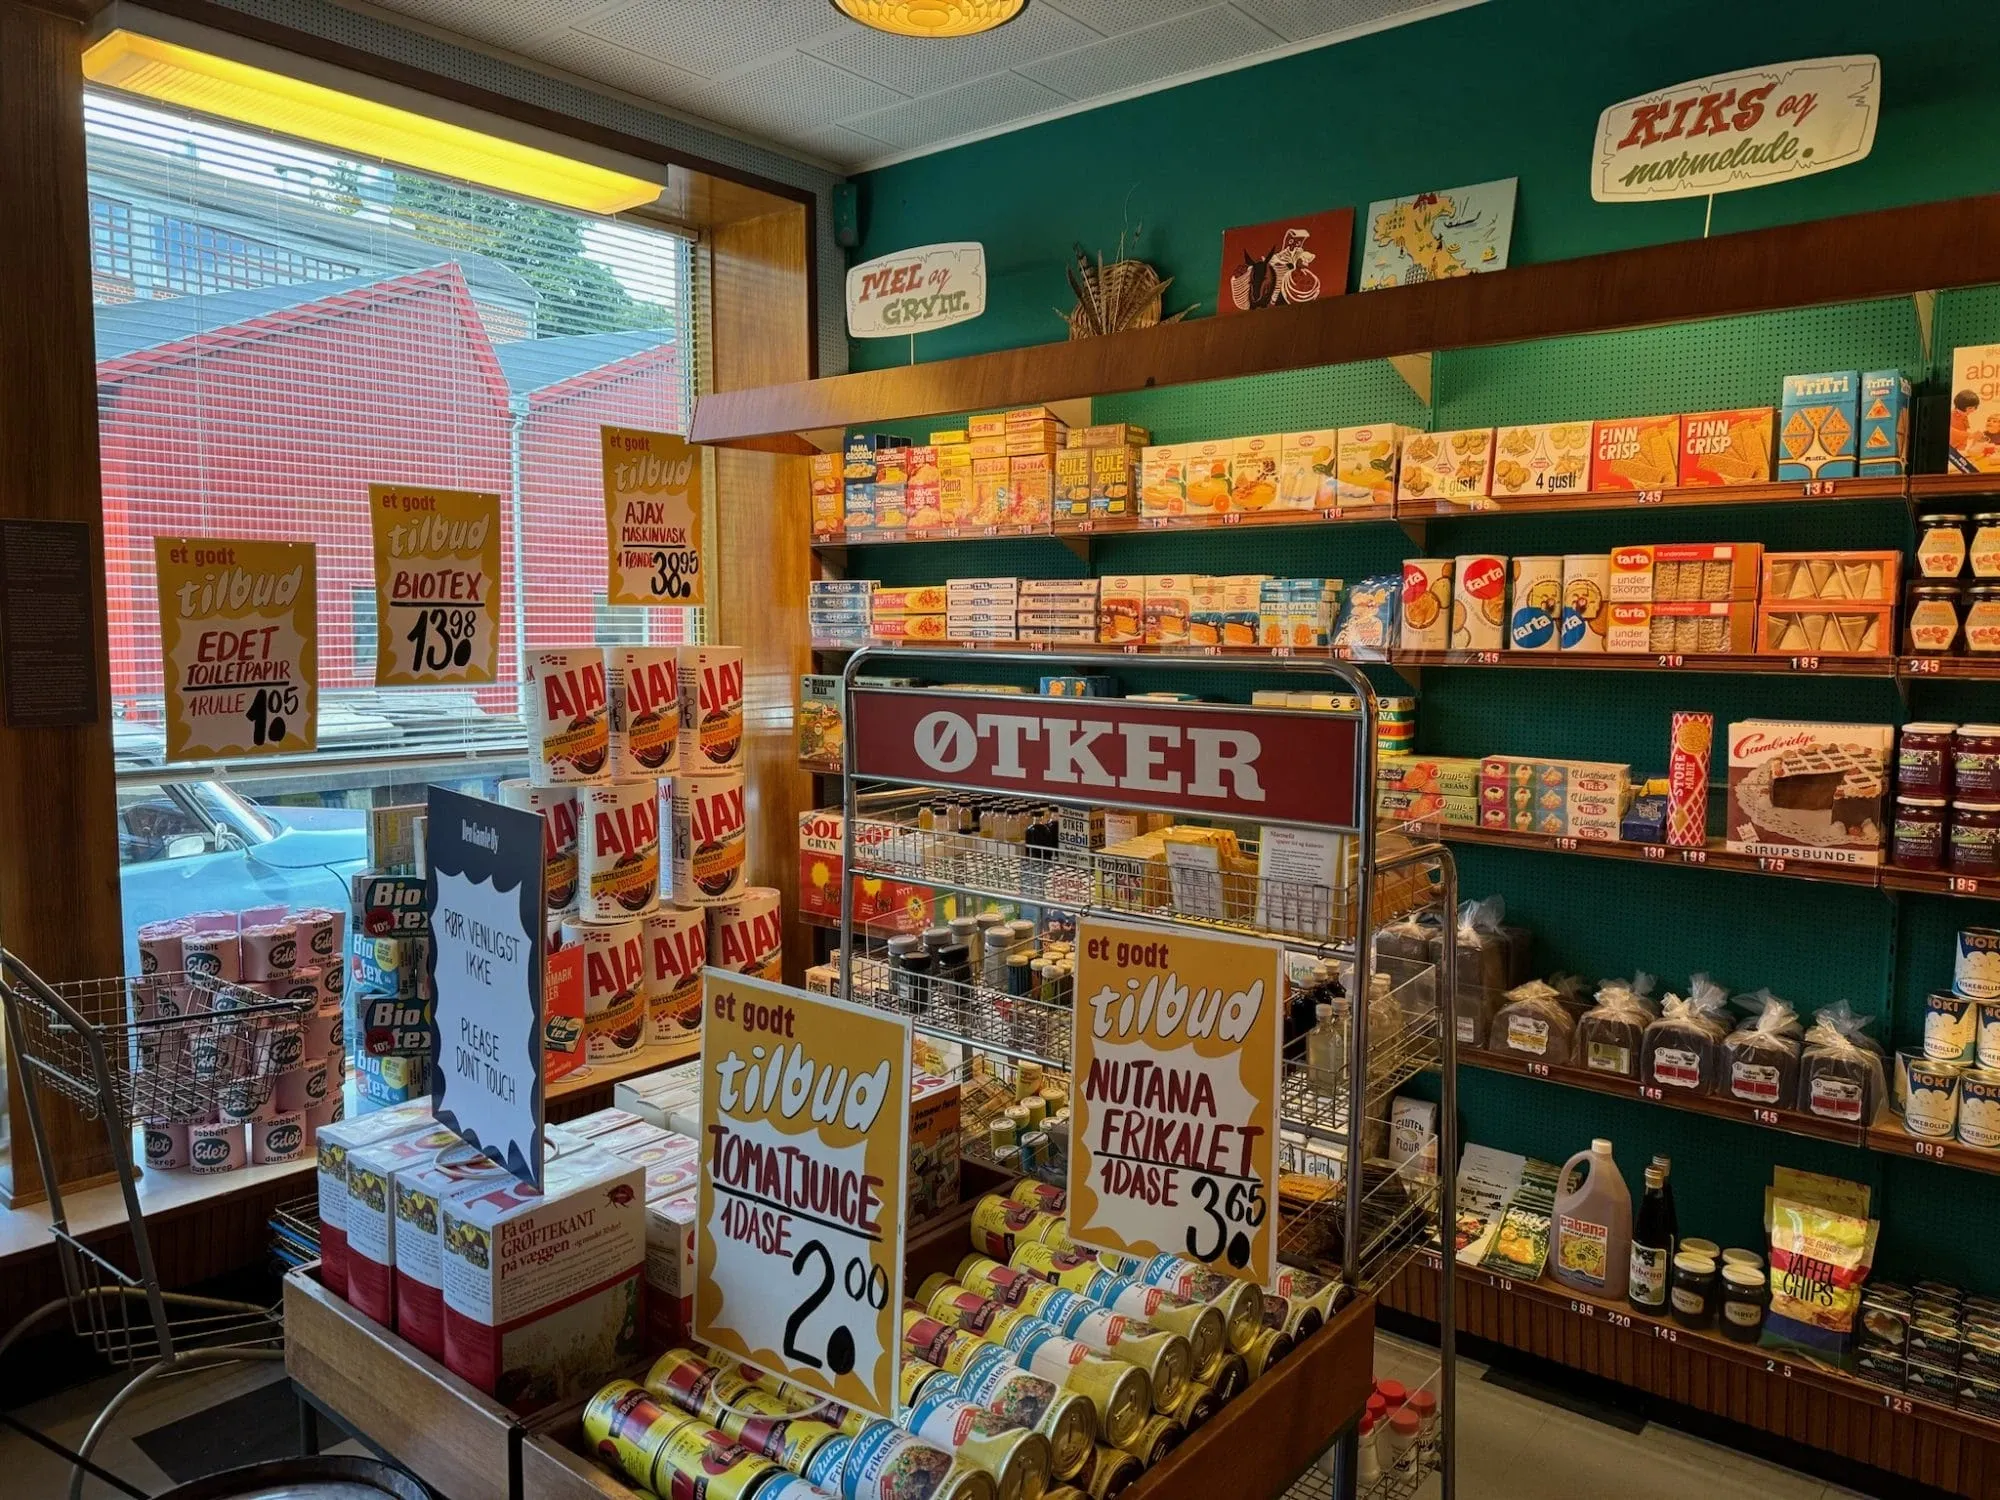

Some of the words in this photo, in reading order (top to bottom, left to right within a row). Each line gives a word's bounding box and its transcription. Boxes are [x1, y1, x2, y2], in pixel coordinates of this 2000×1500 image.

[1617, 81, 1778, 150] KIKS
[1776, 92, 1818, 127] og
[1619, 131, 1814, 187] marmelade.
[859, 263, 924, 303] MEL
[928, 267, 951, 295] og
[1795, 376, 1849, 396] TriTri
[1600, 426, 1639, 444] FINN
[1687, 419, 1730, 438] FINN
[610, 435, 621, 448] et
[625, 436, 650, 452] godt
[1600, 443, 1641, 461] CRISP
[1687, 437, 1732, 456] CRISP
[614, 453, 693, 492] tilbud
[1057, 457, 1086, 477] GULE
[1093, 454, 1124, 474] GULE
[1438, 476, 1447, 493] 4
[1536, 474, 1545, 489] 4
[1548, 471, 1578, 494] gusti
[1803, 481, 1835, 496] 135
[383, 493, 398, 509] et
[402, 495, 436, 513] godt
[1638, 490, 1662, 504] 245
[625, 501, 664, 525] AJAX
[387, 513, 490, 558] tilbud
[622, 526, 687, 544] MASKINVASK
[170, 547, 189, 564] et
[195, 547, 235, 567] godt
[1616, 553, 1650, 565] tarta
[392, 569, 481, 602] BIOTEX
[1466, 565, 1505, 590] tarta
[1617, 575, 1646, 585] under
[176, 565, 303, 618] tilbud
[1614, 607, 1647, 618] tarta
[1615, 629, 1643, 639] under
[199, 626, 280, 664] EDET
[1659, 655, 1684, 667] 210
[1791, 658, 1819, 670] 185
[1910, 659, 1940, 673] 245
[187, 660, 291, 686] TOILETPAPIR
[913, 709, 1266, 802] ØTKER
[1733, 731, 1816, 760] Cambridge
[1673, 753, 1686, 797] STORE
[1686, 762, 1696, 790] MARIE
[462, 818, 473, 843] Den
[473, 822, 490, 849] Gamle
[490, 827, 499, 855] By
[802, 819, 842, 840] SOL
[1060, 831, 1088, 846] stabil
[808, 838, 836, 851] GRYN
[1556, 838, 1577, 850] 195
[1643, 847, 1665, 859] 130
[1744, 844, 1856, 863] SIRUPSBUNDE
[1682, 850, 1706, 863] 198
[1759, 857, 1785, 872] 175
[1949, 876, 1977, 892] 185
[373, 882, 421, 907] Bio
[371, 922, 391, 934] 10%
[445, 908, 465, 940] RØR
[468, 918, 520, 964] VENLIGST
[353, 933, 373, 959] Bio
[1087, 936, 1110, 962] et
[1117, 943, 1169, 970] godt
[186, 956, 219, 974] Edet
[466, 951, 492, 986] IKKE
[373, 1002, 421, 1027] Bio
[714, 991, 736, 1022] et
[743, 1001, 795, 1039] godt
[1089, 972, 1265, 1043] tilbud
[461, 1017, 500, 1062] PLEASE
[550, 1027, 568, 1040] tex
[373, 1042, 391, 1053] 10%
[484, 1063, 516, 1106] TOUCH
[716, 1042, 890, 1134] tilbud
[1086, 1058, 1217, 1118] NUTANA
[1640, 1085, 1662, 1100] 145
[1753, 1108, 1779, 1124] 145
[270, 1129, 303, 1147] Edet
[1395, 1119, 1425, 1137] GLUTEN
[195, 1143, 228, 1159] Edet
[1101, 1109, 1265, 1178] FRIKALET
[1396, 1139, 1421, 1153] FLOUR
[1915, 1141, 1945, 1159] 098
[708, 1125, 884, 1234] TOMATJUICE
[501, 1220, 517, 1241] Få
[519, 1217, 534, 1234] en
[1560, 1215, 1607, 1238] cabana
[500, 1256, 518, 1279] på
[520, 1239, 570, 1266] væggen
[1788, 1251, 1835, 1286] TAFFEL
[1783, 1272, 1834, 1307] CHIPS
[1571, 1300, 1594, 1317] 695
[1608, 1312, 1631, 1328] 220
[1653, 1325, 1677, 1342] 145
[812, 1438, 849, 1482] Nutan
[848, 1423, 893, 1480] Nutana
